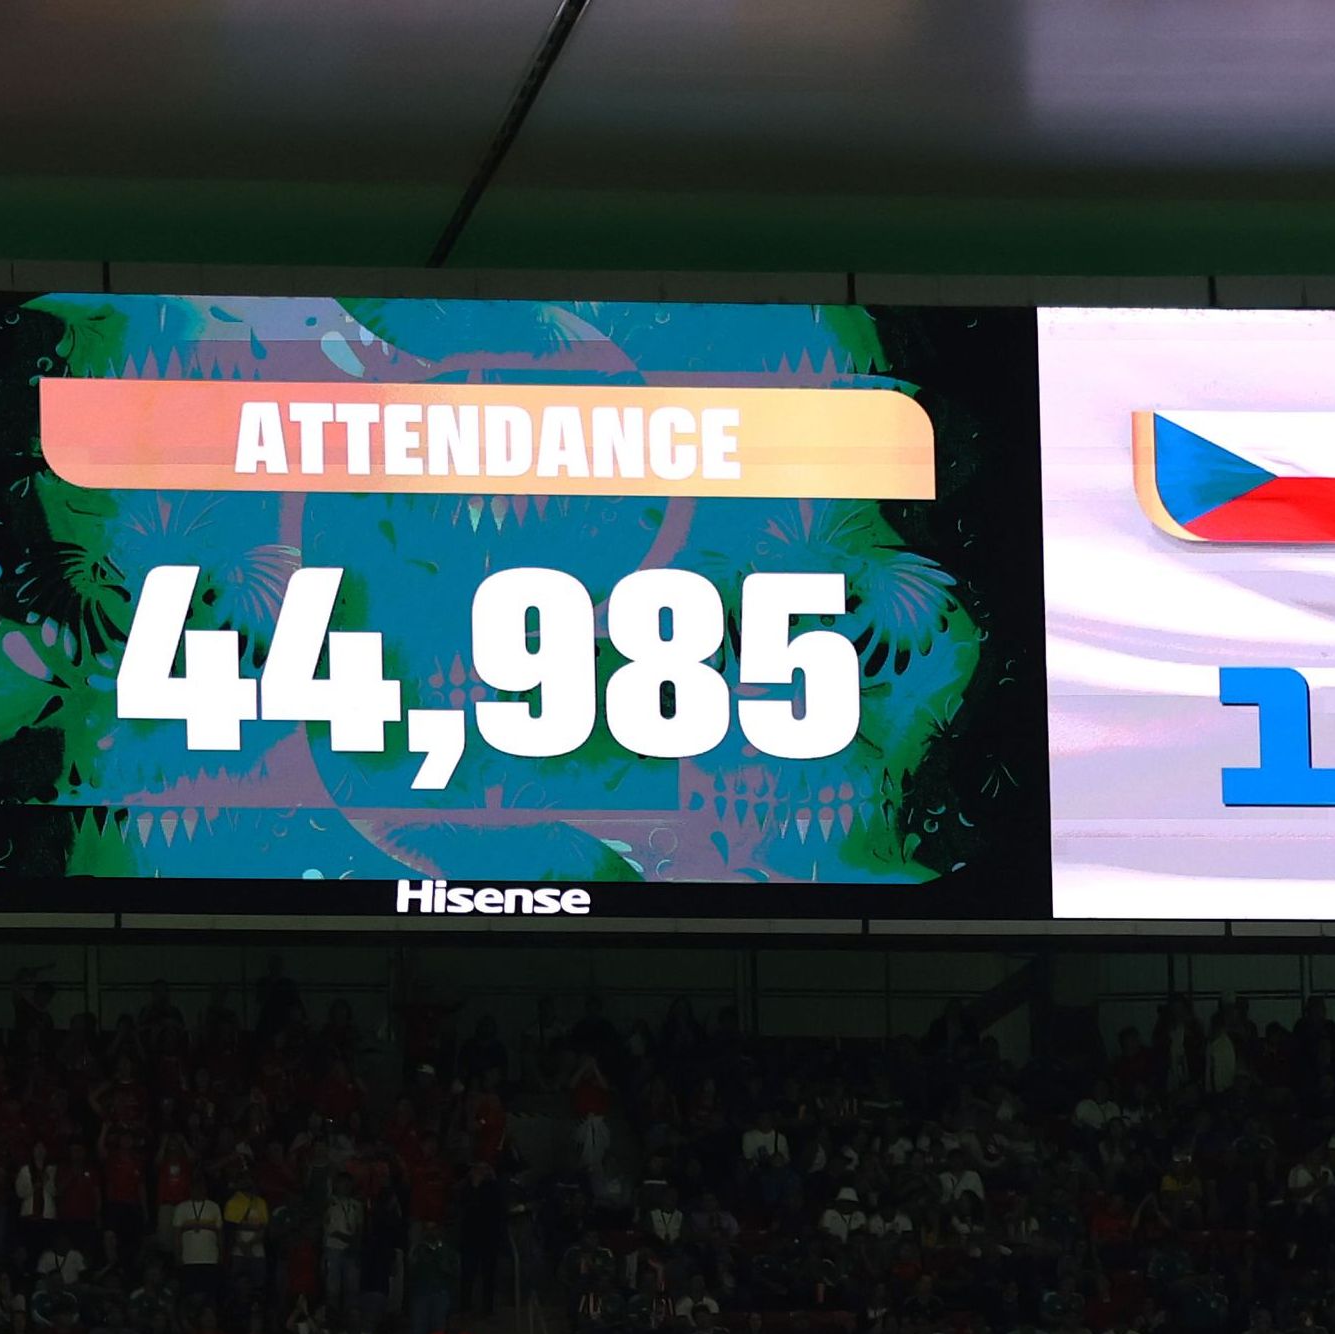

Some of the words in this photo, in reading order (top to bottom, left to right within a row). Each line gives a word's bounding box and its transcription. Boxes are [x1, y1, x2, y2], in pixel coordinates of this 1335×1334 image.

[235, 402, 743, 484] ATTENDANCE
[116, 567, 861, 790] 44,985
[394, 880, 592, 917] Hisense
